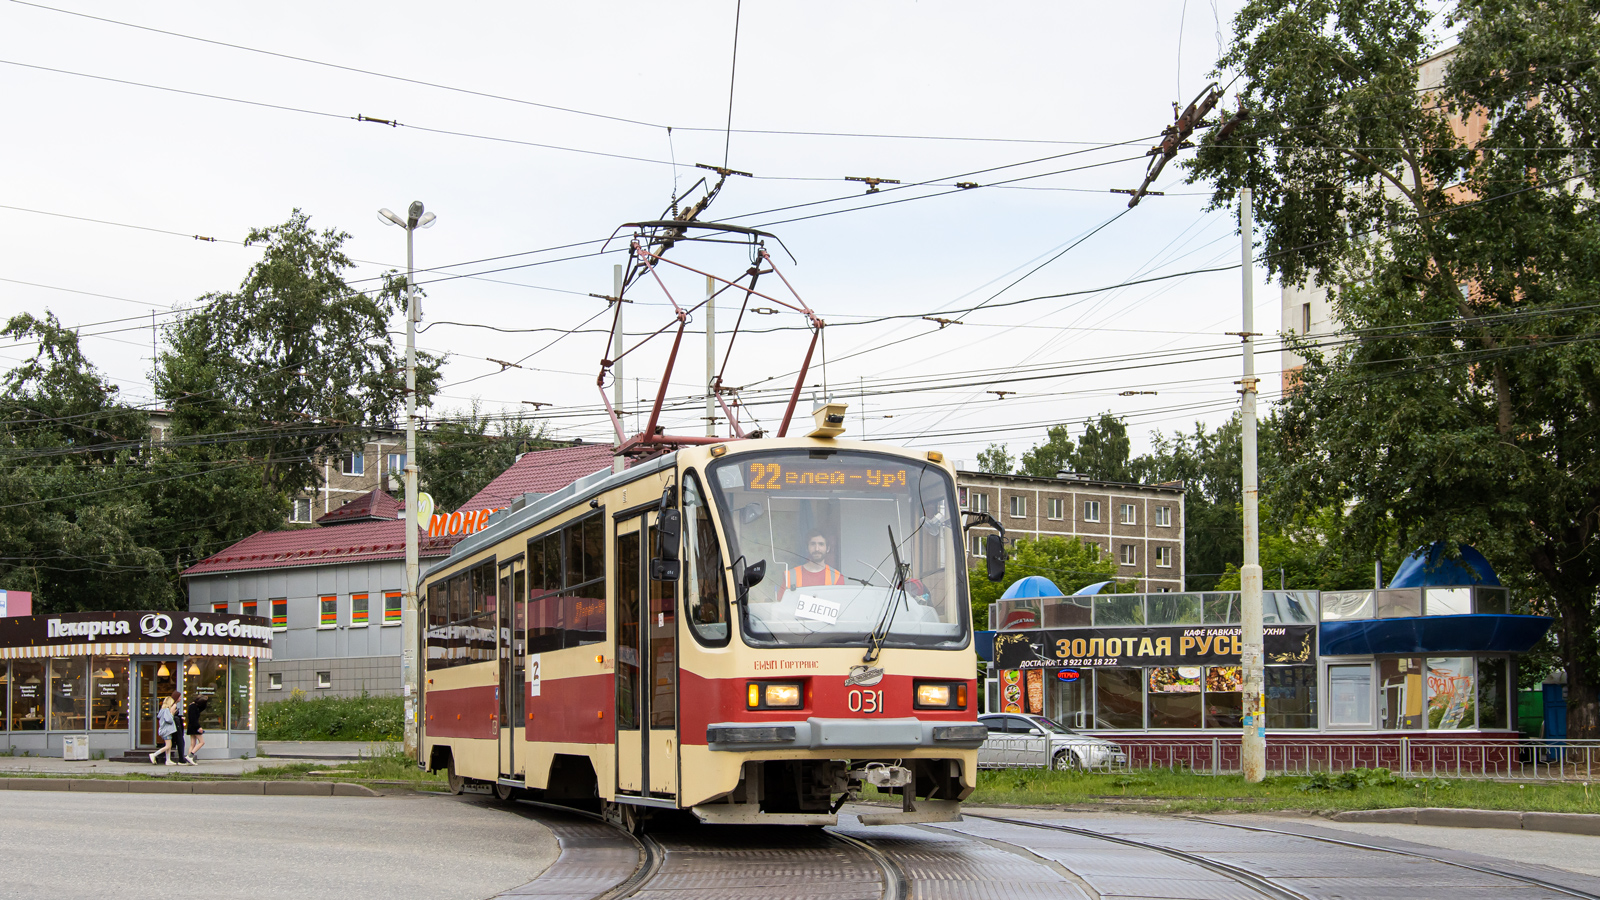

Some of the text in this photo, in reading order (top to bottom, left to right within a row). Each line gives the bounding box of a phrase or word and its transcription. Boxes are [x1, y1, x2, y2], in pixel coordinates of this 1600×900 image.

[750, 463, 781, 489] 22
[796, 600, 839, 618] В ДЕПО
[47, 616, 274, 644] Пекарня Хлебница
[1184, 629, 1205, 637] КАФЕ
[1056, 637, 1171, 658] ЗОЛОТАЯ
[1179, 636, 1242, 656] РУСЬ
[533, 661, 539, 680] 2
[848, 689, 884, 713] 031
